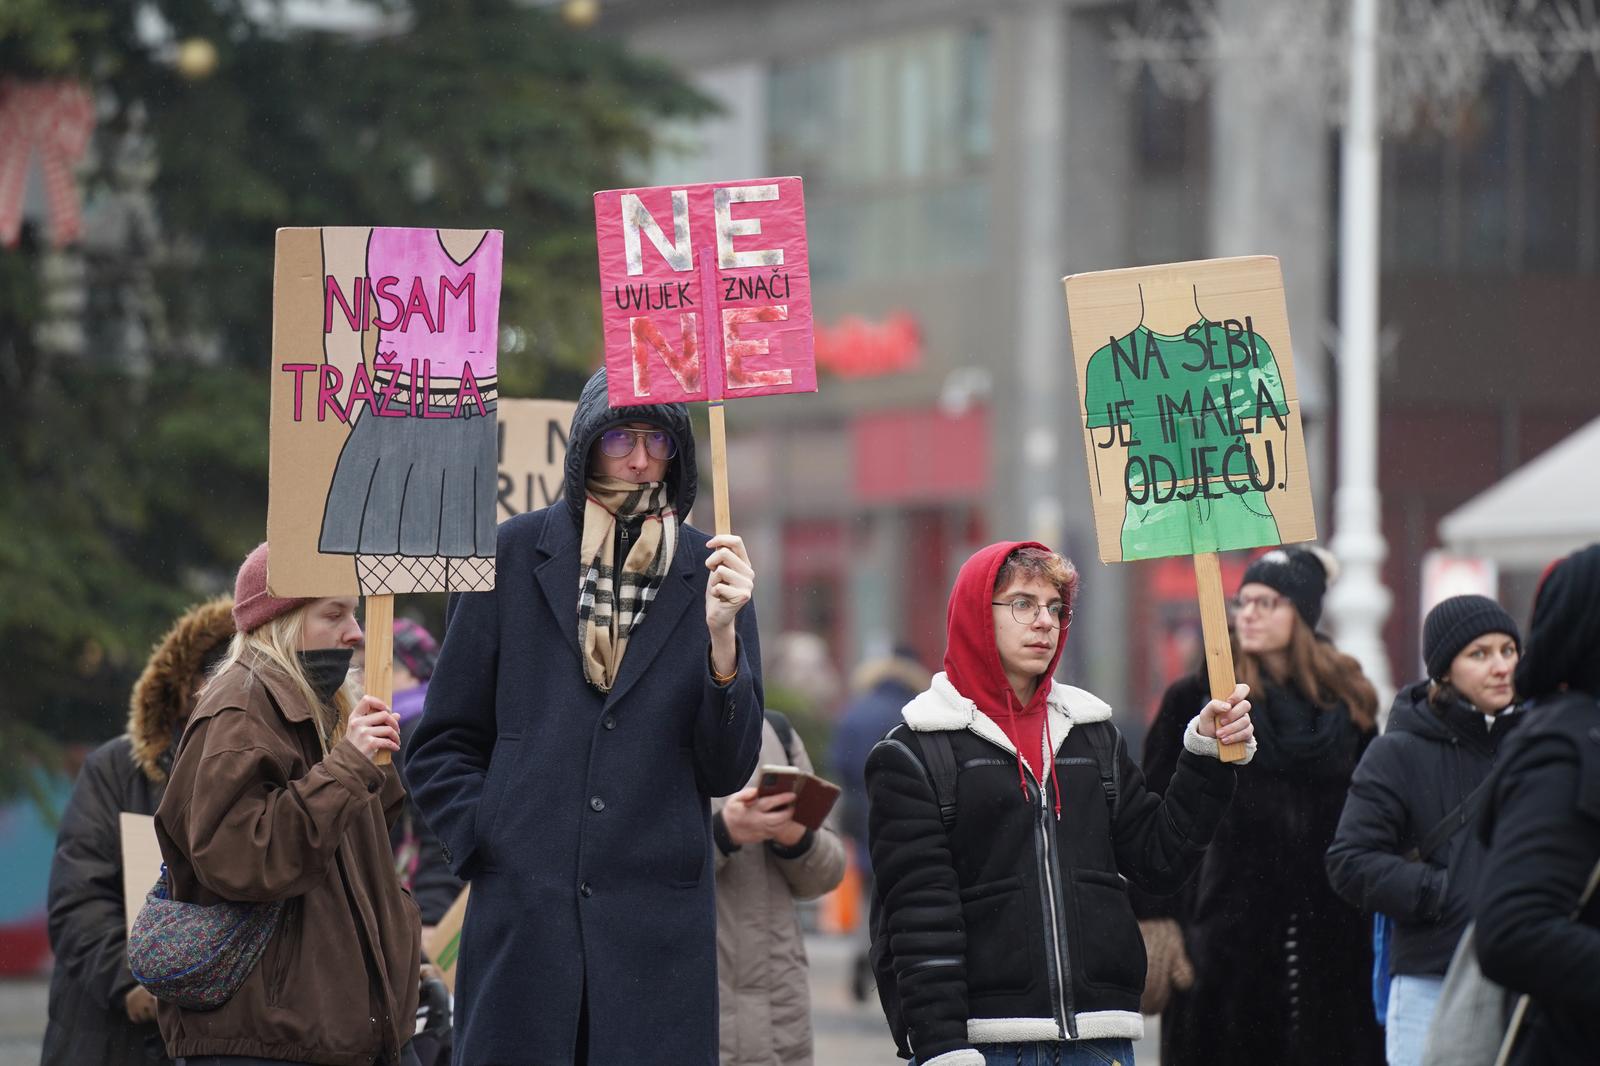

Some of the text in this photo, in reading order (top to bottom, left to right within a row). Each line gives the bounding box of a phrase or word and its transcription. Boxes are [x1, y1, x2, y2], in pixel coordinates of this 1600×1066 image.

[620, 184, 785, 276] NE
[325, 273, 476, 333] NISAM
[615, 268, 790, 311] UVIJEK ZNAČI
[630, 304, 793, 397] NE
[1109, 316, 1260, 382] NA SEBI
[282, 351, 487, 423] TRAŽILA
[1098, 378, 1287, 449] JE IMALA
[1124, 437, 1285, 506] ODJEĆU.
